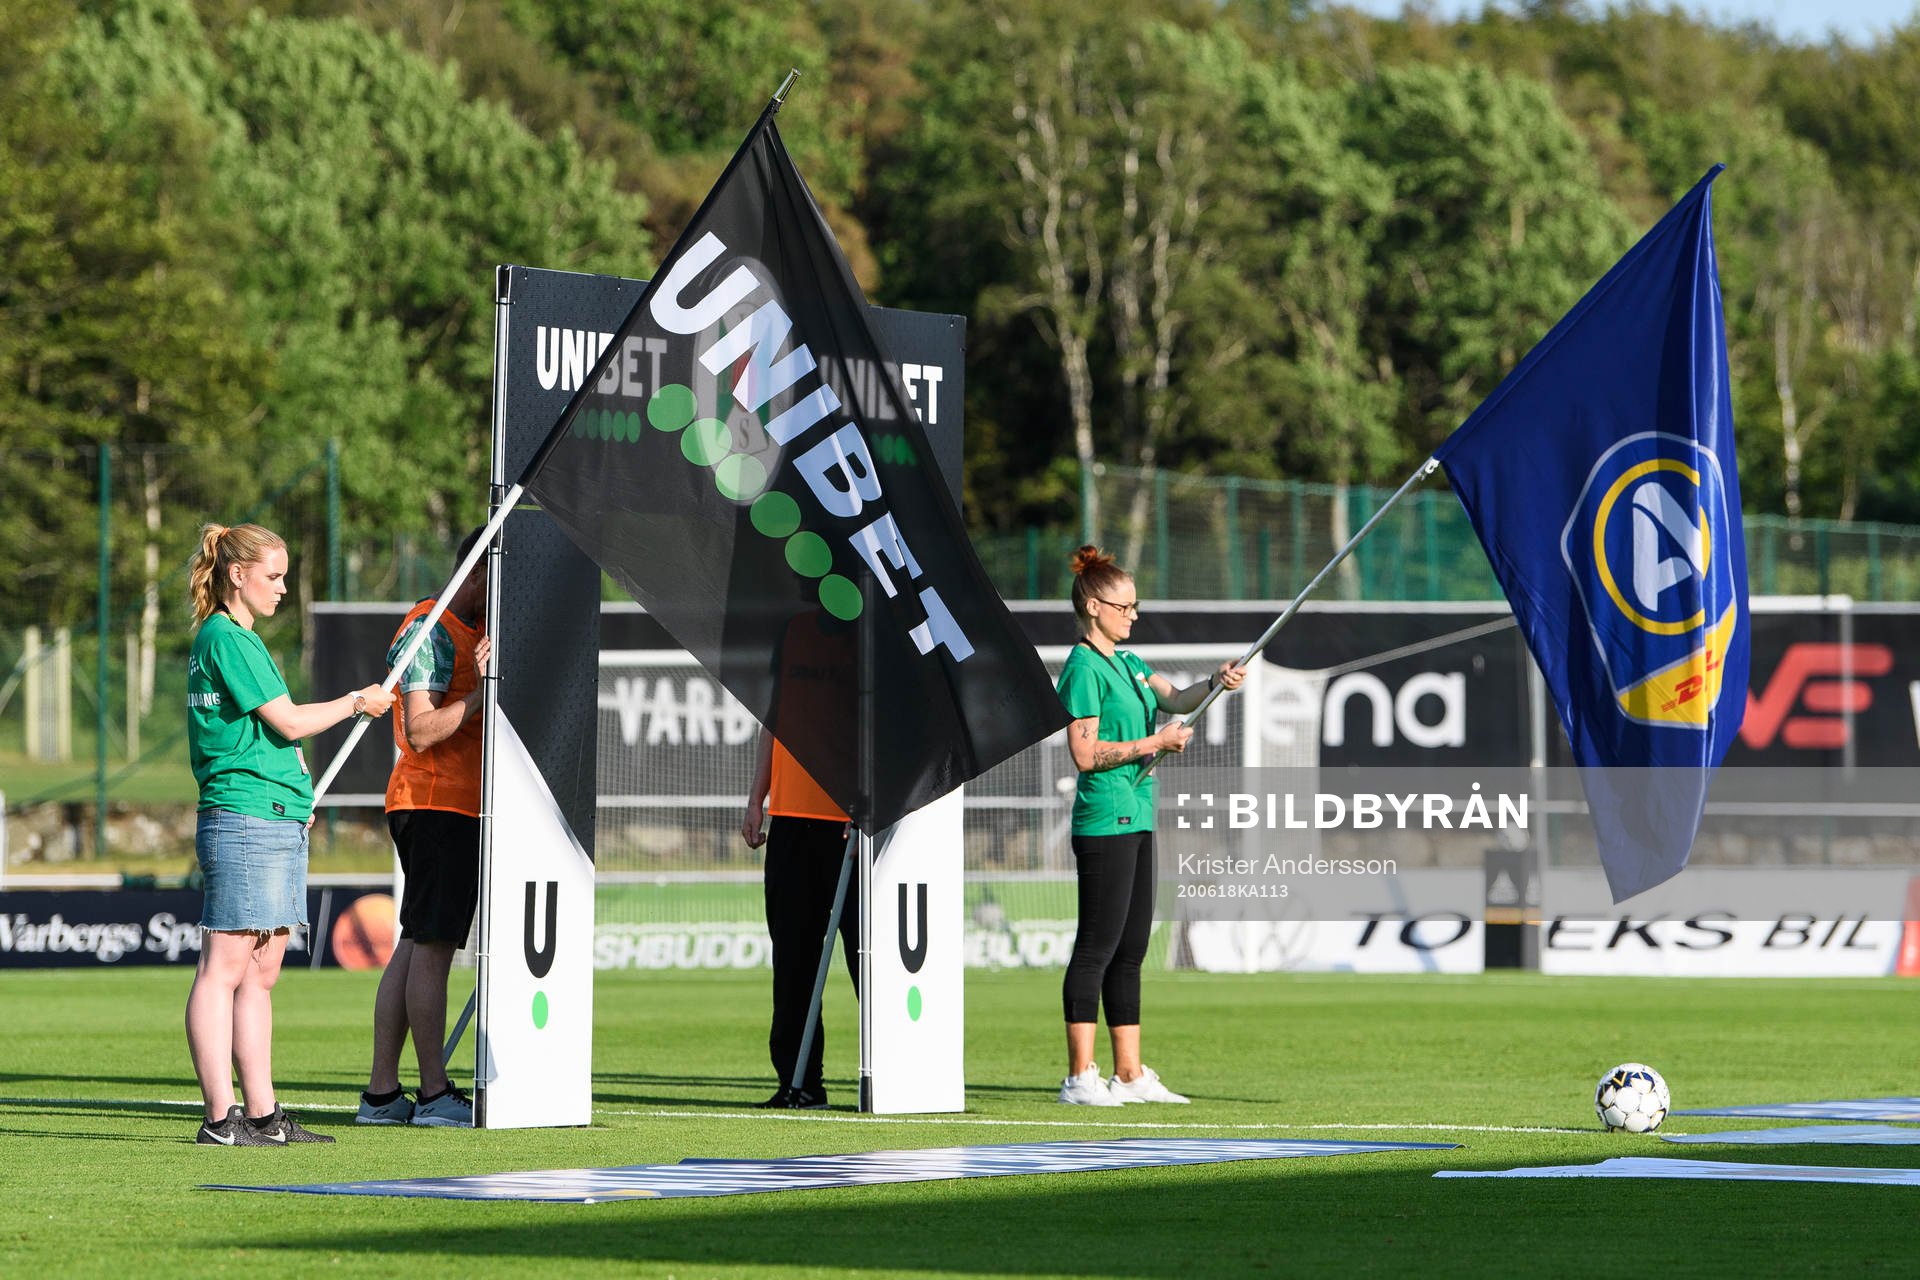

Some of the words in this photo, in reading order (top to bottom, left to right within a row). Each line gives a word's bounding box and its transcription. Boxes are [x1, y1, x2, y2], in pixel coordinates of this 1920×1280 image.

[537, 326, 667, 398] UNIBET
[650, 231, 975, 662] UNIBET
[615, 676, 758, 746] VARB
[0, 913, 142, 962] Varbergs
[1761, 912, 1878, 950] BIL
